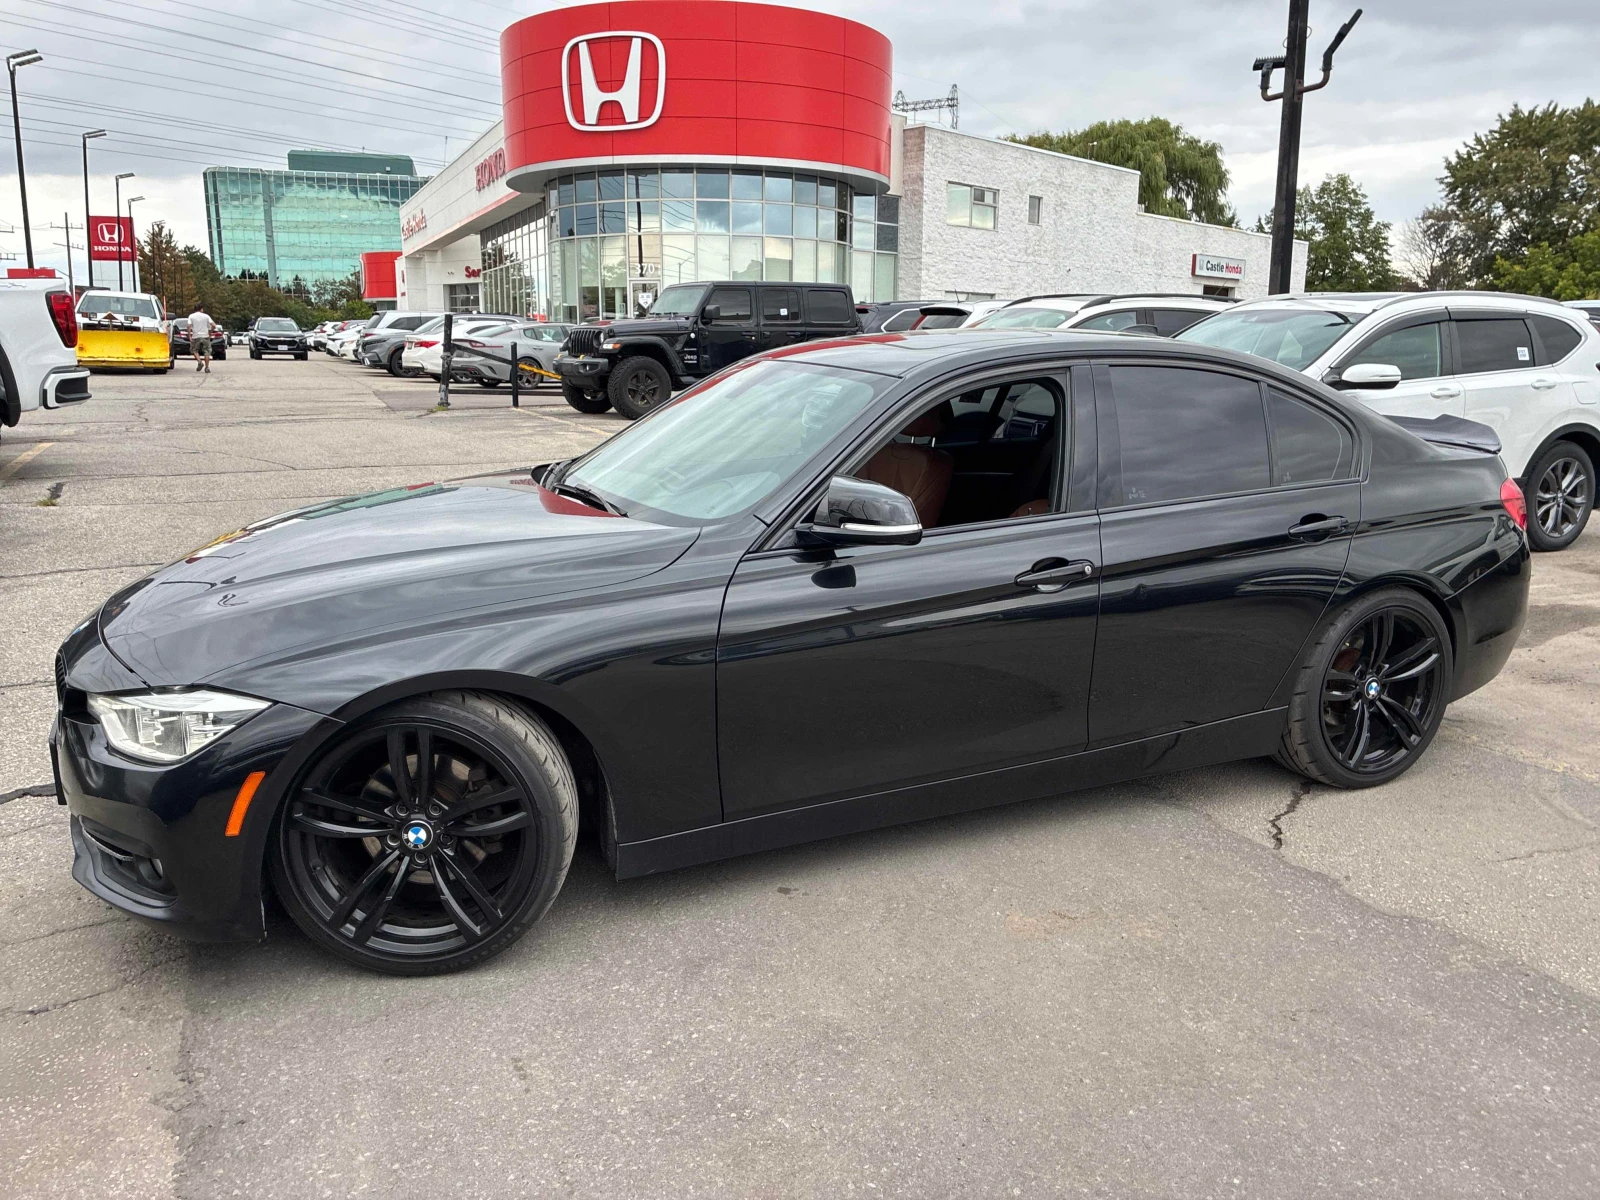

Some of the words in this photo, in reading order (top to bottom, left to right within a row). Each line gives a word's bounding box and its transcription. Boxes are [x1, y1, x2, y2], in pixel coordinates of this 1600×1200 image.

[475, 147, 505, 192] HOND
[464, 265, 481, 278] Ser
[635, 263, 655, 275] 370
[1206, 260, 1224, 272] Castle
[1225, 262, 1242, 274] Honda
